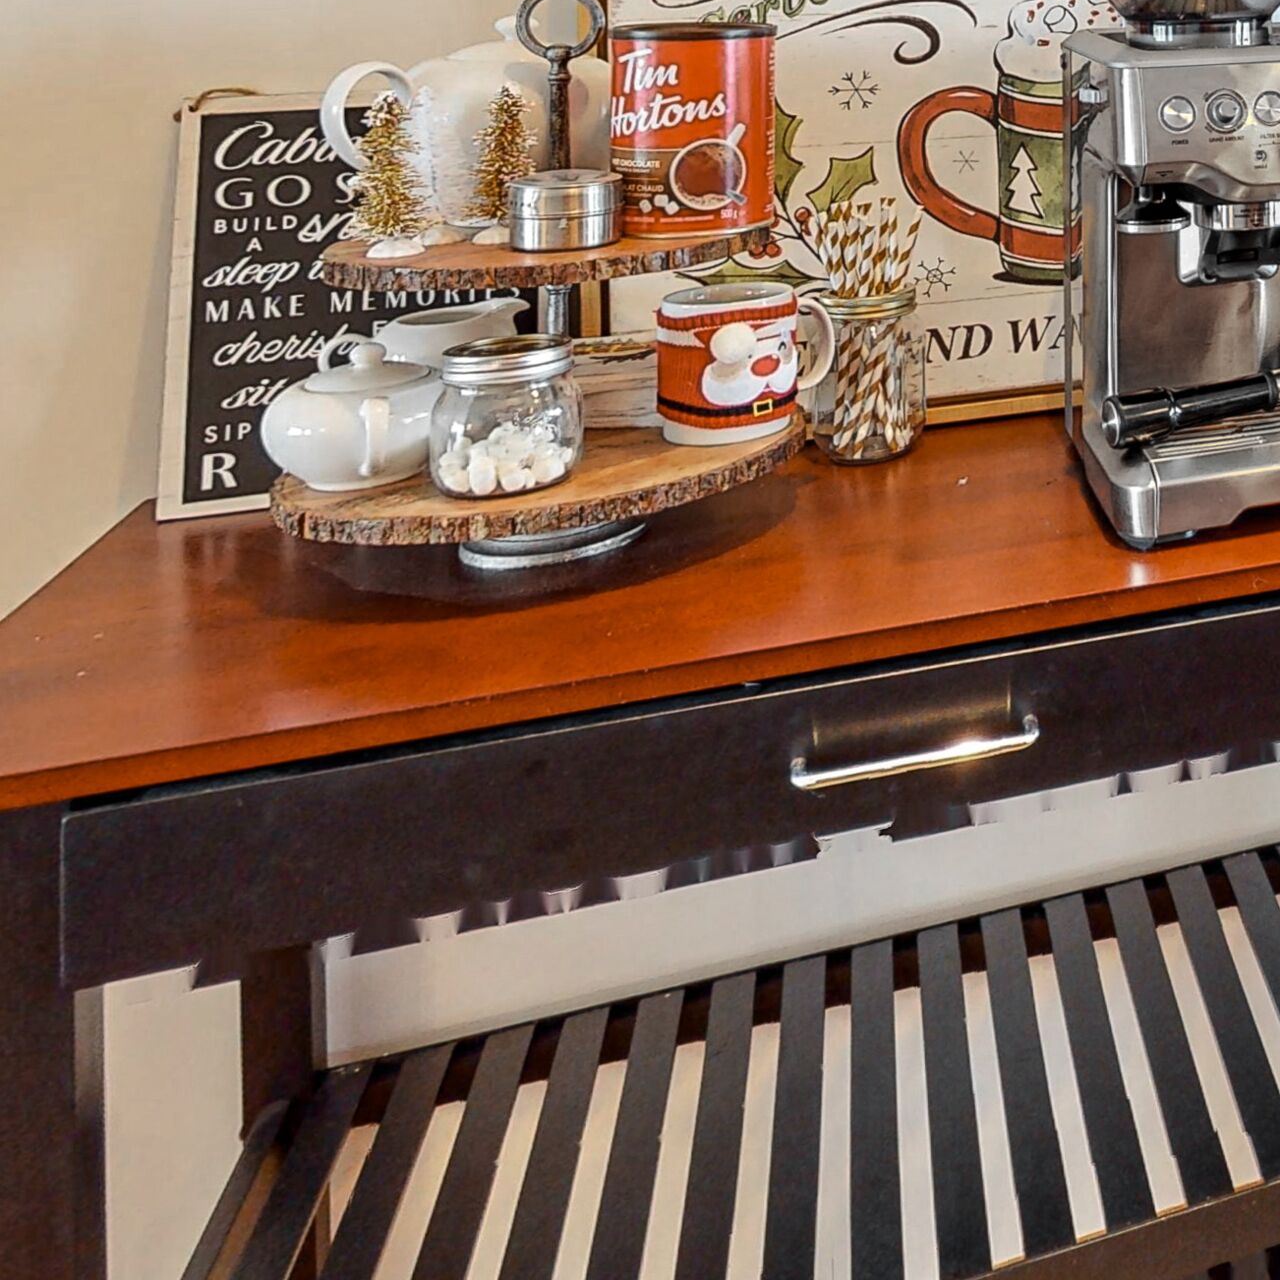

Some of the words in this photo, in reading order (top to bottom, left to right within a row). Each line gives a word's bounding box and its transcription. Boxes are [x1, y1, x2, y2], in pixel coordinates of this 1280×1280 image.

[618, 48, 678, 94] Tim
[610, 92, 727, 138] Hortons
[214, 174, 312, 210] GO
[213, 214, 298, 235] BUILD
[245, 236, 263, 253] A
[202, 255, 300, 293] sleep
[205, 294, 305, 323] MAKE
[220, 377, 290, 410] sit
[203, 422, 253, 444] SIP
